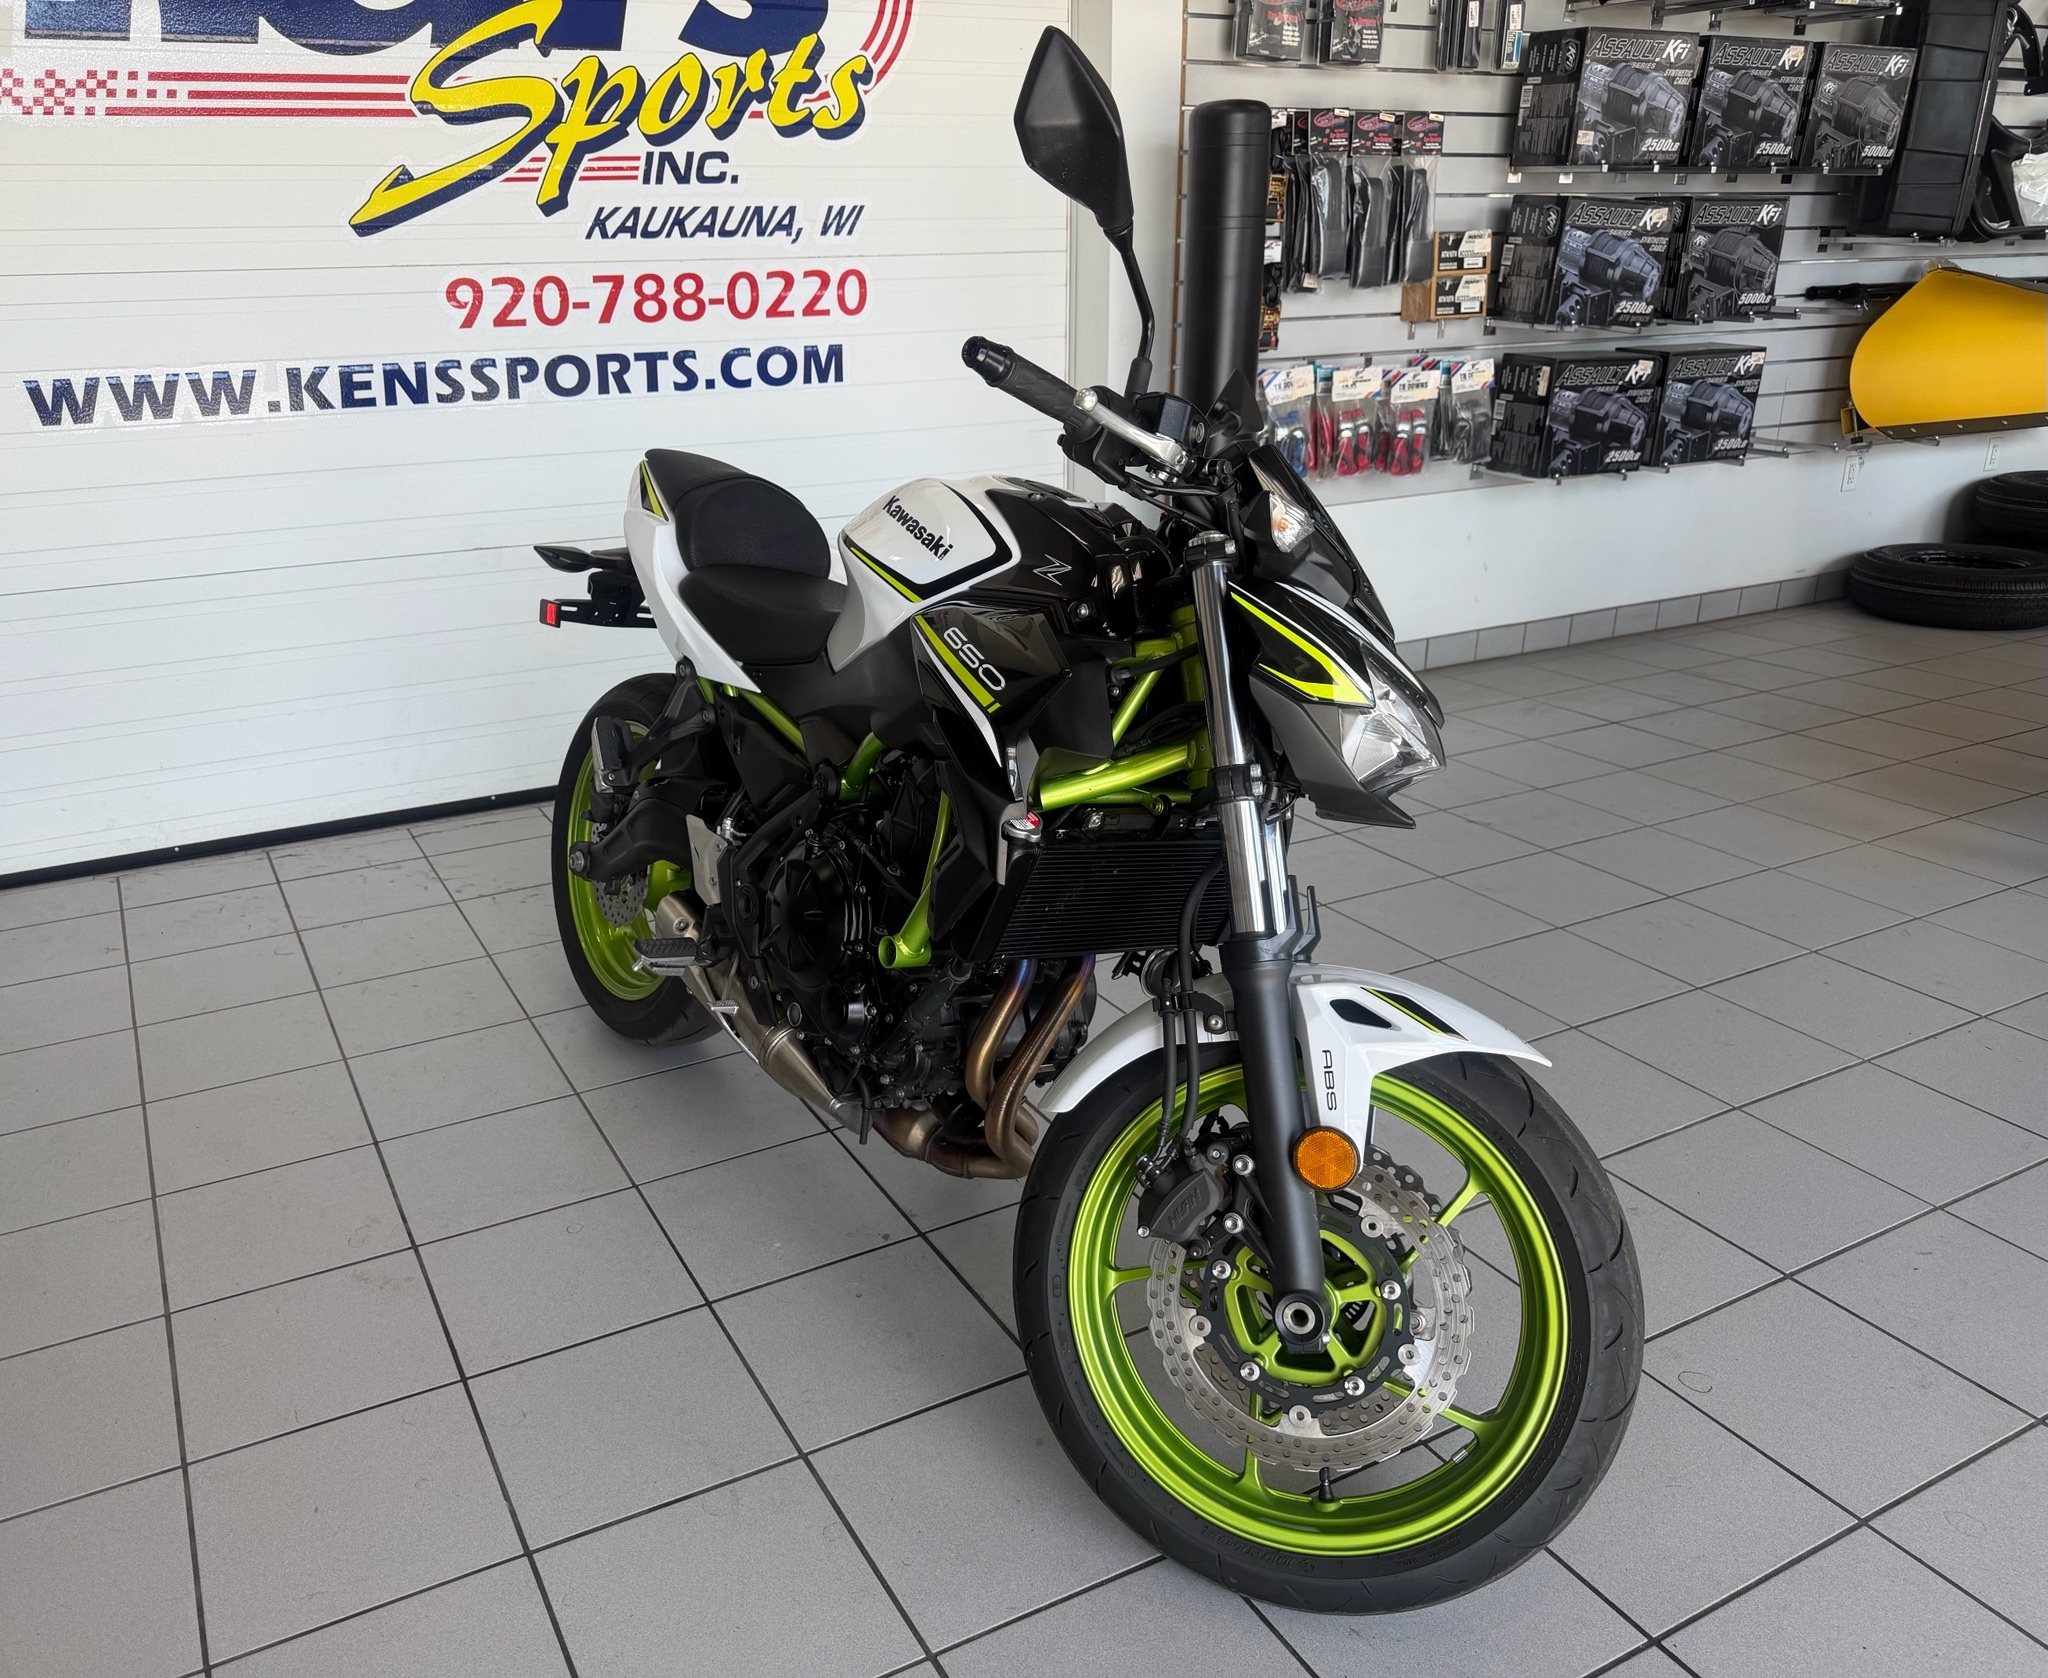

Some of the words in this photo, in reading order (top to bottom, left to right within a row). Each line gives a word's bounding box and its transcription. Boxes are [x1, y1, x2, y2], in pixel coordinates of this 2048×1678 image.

[1586, 34, 1666, 60] ASSAULT
[1661, 39, 1692, 63] KFi
[1710, 43, 1782, 67] ASSAULT
[1631, 62, 1657, 70] SERIES
[1664, 69, 1694, 78] SYNTHETIC
[1750, 69, 1773, 77] SERIES
[1822, 50, 1889, 73] ASSAULT
[1884, 54, 1910, 77] KFi
[1673, 78, 1693, 86] CABLE
[349, 0, 873, 237] Sports
[641, 150, 739, 186] INC.
[585, 205, 803, 244] KAUKAUNA,
[819, 204, 865, 237] WI
[1566, 202, 1644, 227] ASSAULT
[1691, 203, 1760, 225] ASSAULT
[1756, 204, 1782, 226] KFi
[1608, 229, 1633, 237] SERIES
[444, 268, 869, 331] 920-788-0220
[1555, 364, 1629, 386] ASSAULT
[1668, 357, 1738, 378] ASSAULT
[23, 342, 845, 428] WWW.KENSSPORTS.COM
[882, 494, 955, 562] Kawasaki
[943, 626, 1007, 692] 650
[1321, 1049, 1338, 1112] ABS
